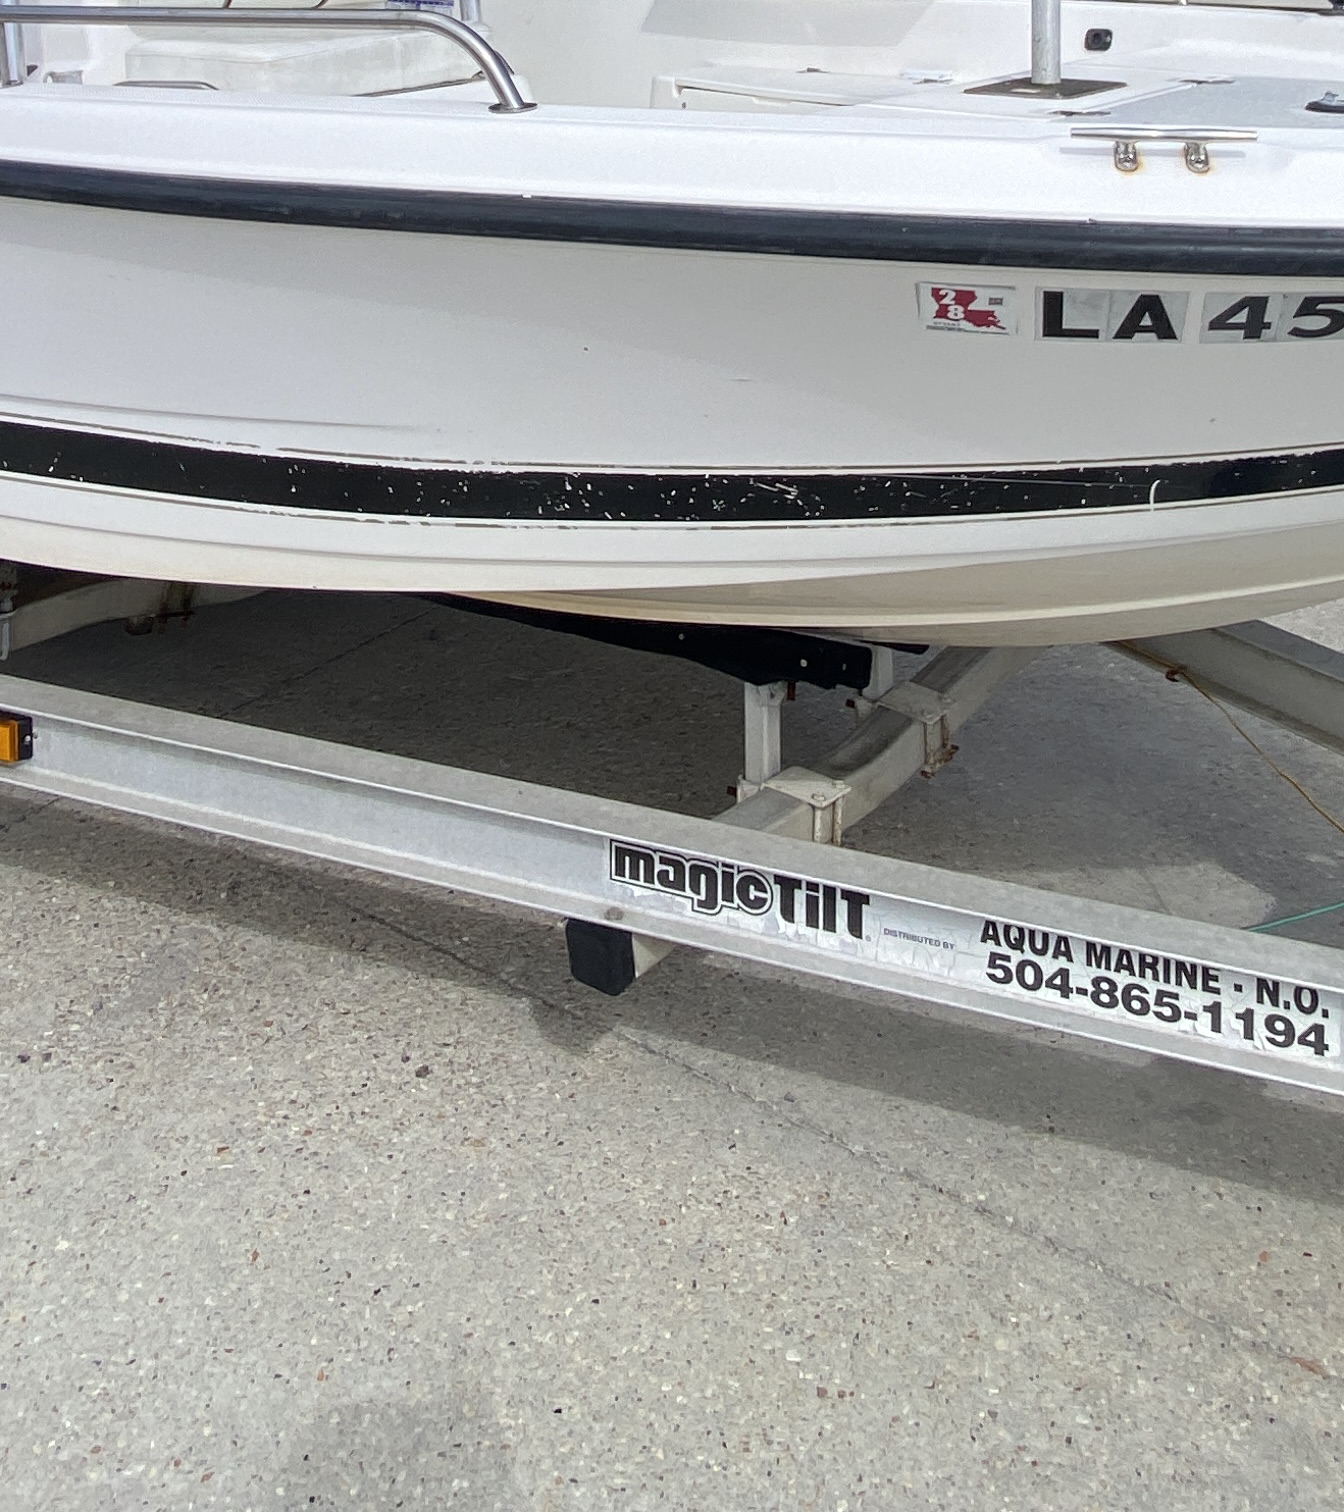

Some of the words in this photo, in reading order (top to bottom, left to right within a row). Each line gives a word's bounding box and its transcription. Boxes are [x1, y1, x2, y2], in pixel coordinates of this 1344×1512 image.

[1042, 290, 1179, 339] LA
[883, 927, 941, 948] DISTRIBUTED
[942, 941, 955, 950] BY
[980, 920, 1074, 963] AQUA
[1085, 941, 1222, 996] MARINE
[1256, 977, 1330, 1019] N.O.
[985, 951, 1330, 1057] 504-865-1194
